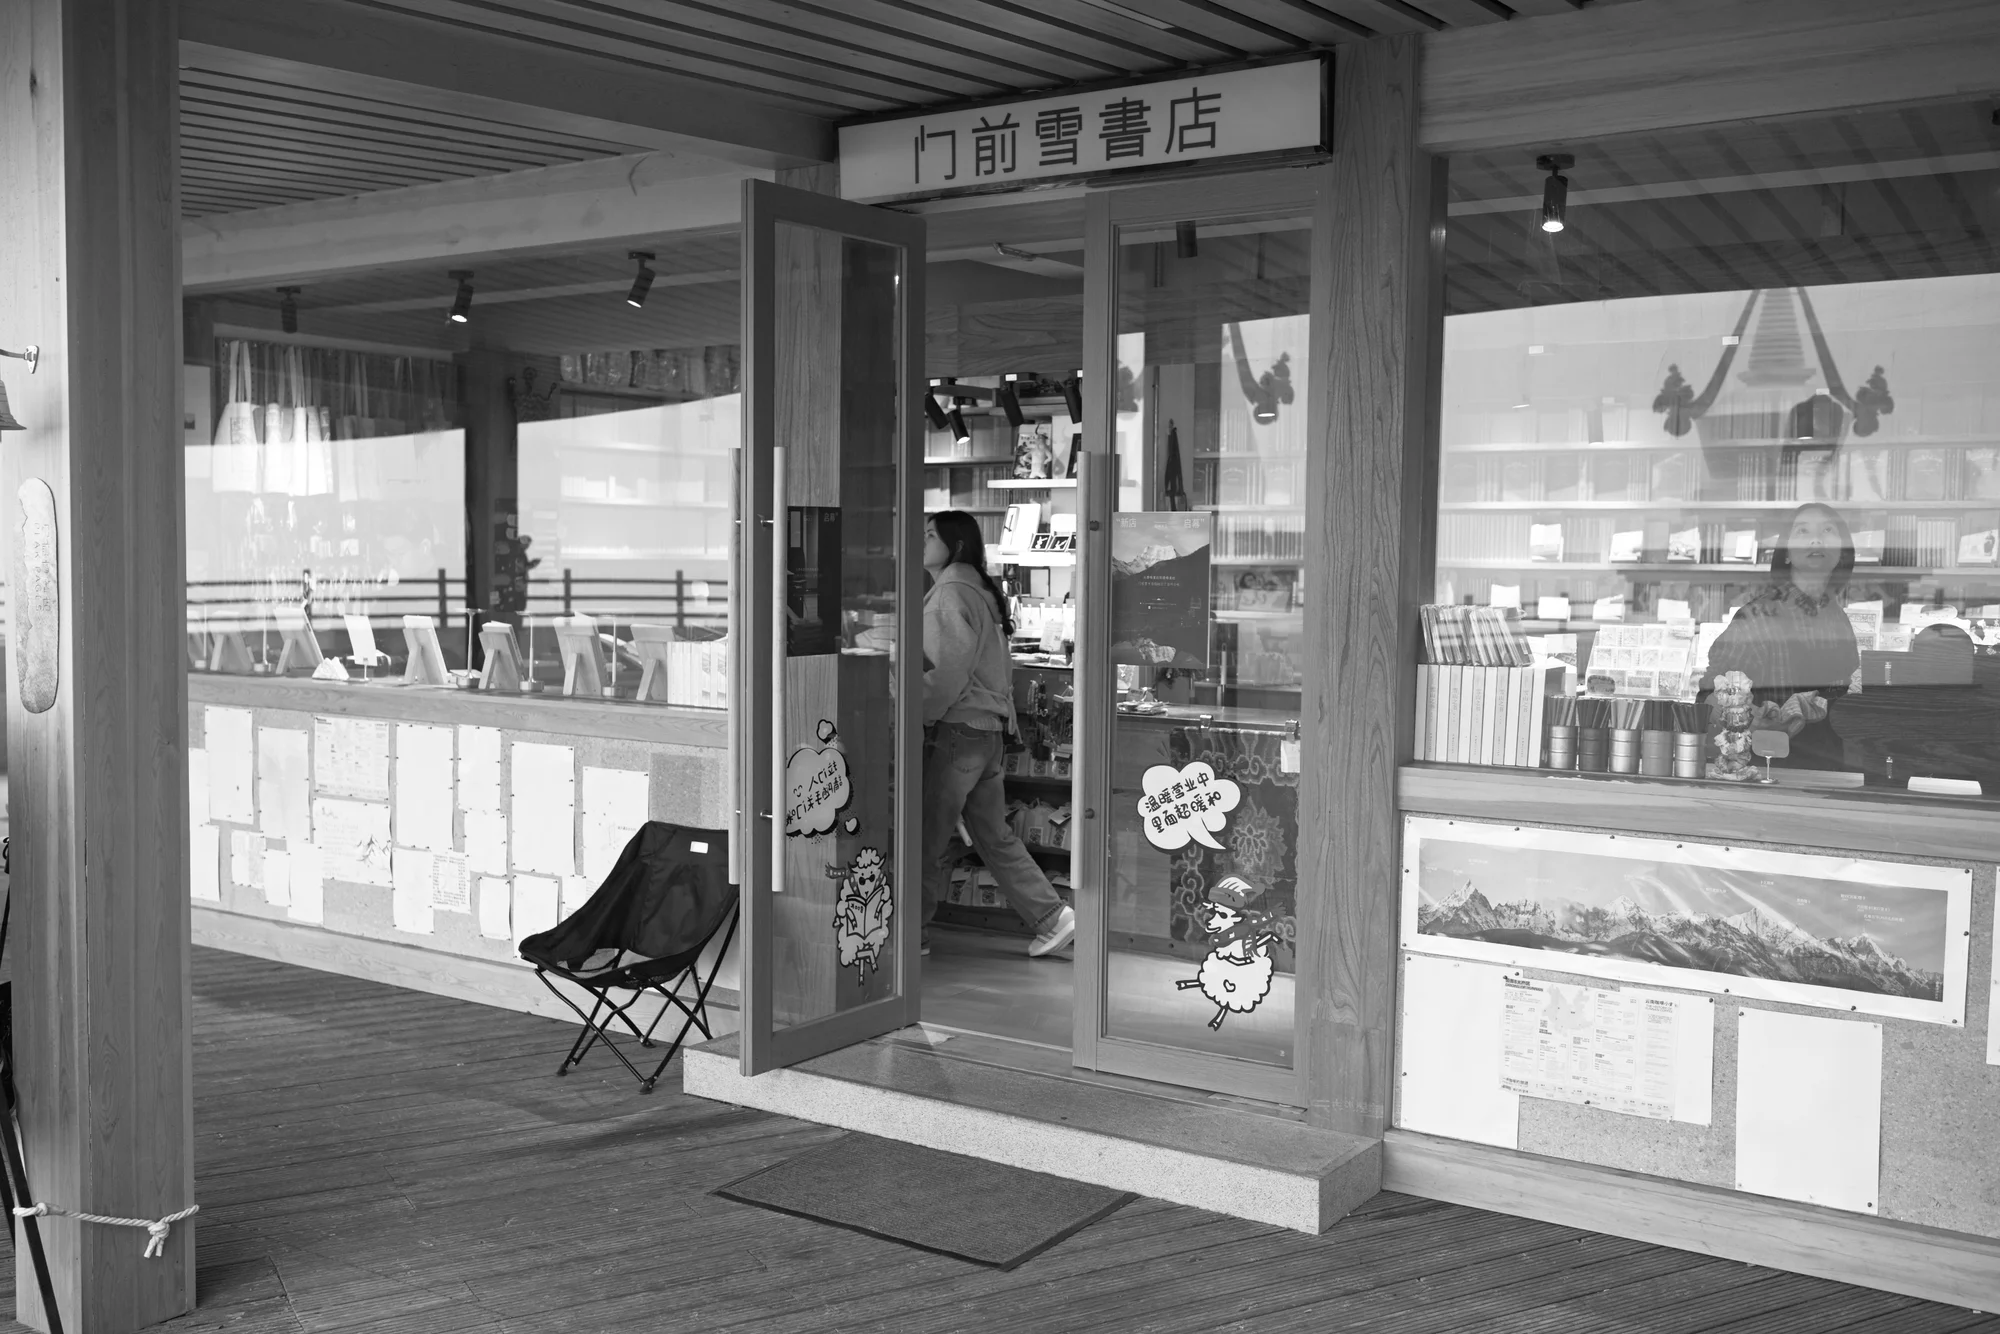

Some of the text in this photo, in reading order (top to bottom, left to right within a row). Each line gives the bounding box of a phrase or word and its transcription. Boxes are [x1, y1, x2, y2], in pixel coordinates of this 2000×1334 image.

[914, 87, 1222, 185] 门前雪書店
[1144, 772, 1210, 814] 温暖营业中
[1151, 790, 1222, 834] 里面超暖和
